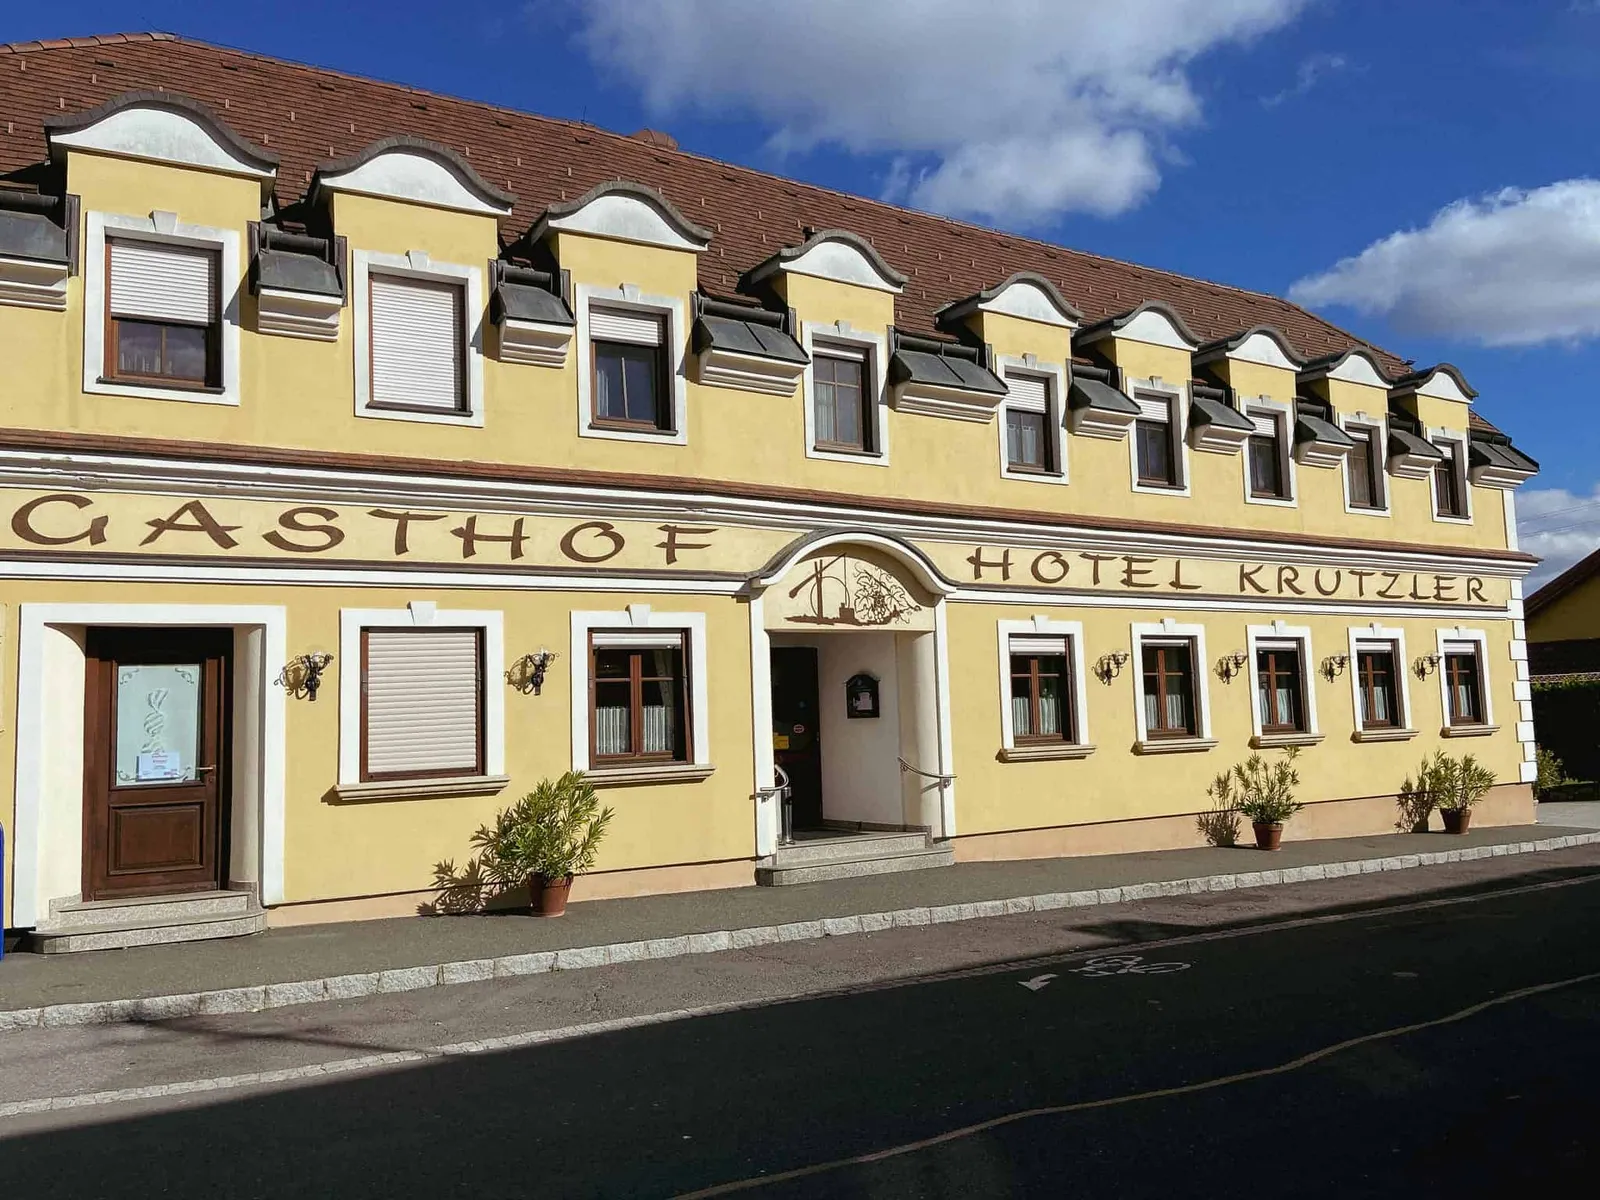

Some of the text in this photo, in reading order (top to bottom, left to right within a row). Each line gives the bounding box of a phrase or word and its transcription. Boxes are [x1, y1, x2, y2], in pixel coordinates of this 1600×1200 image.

[11, 494, 719, 565] GASTHOF
[966, 546, 1489, 602] HOTEL KRUTZLER
